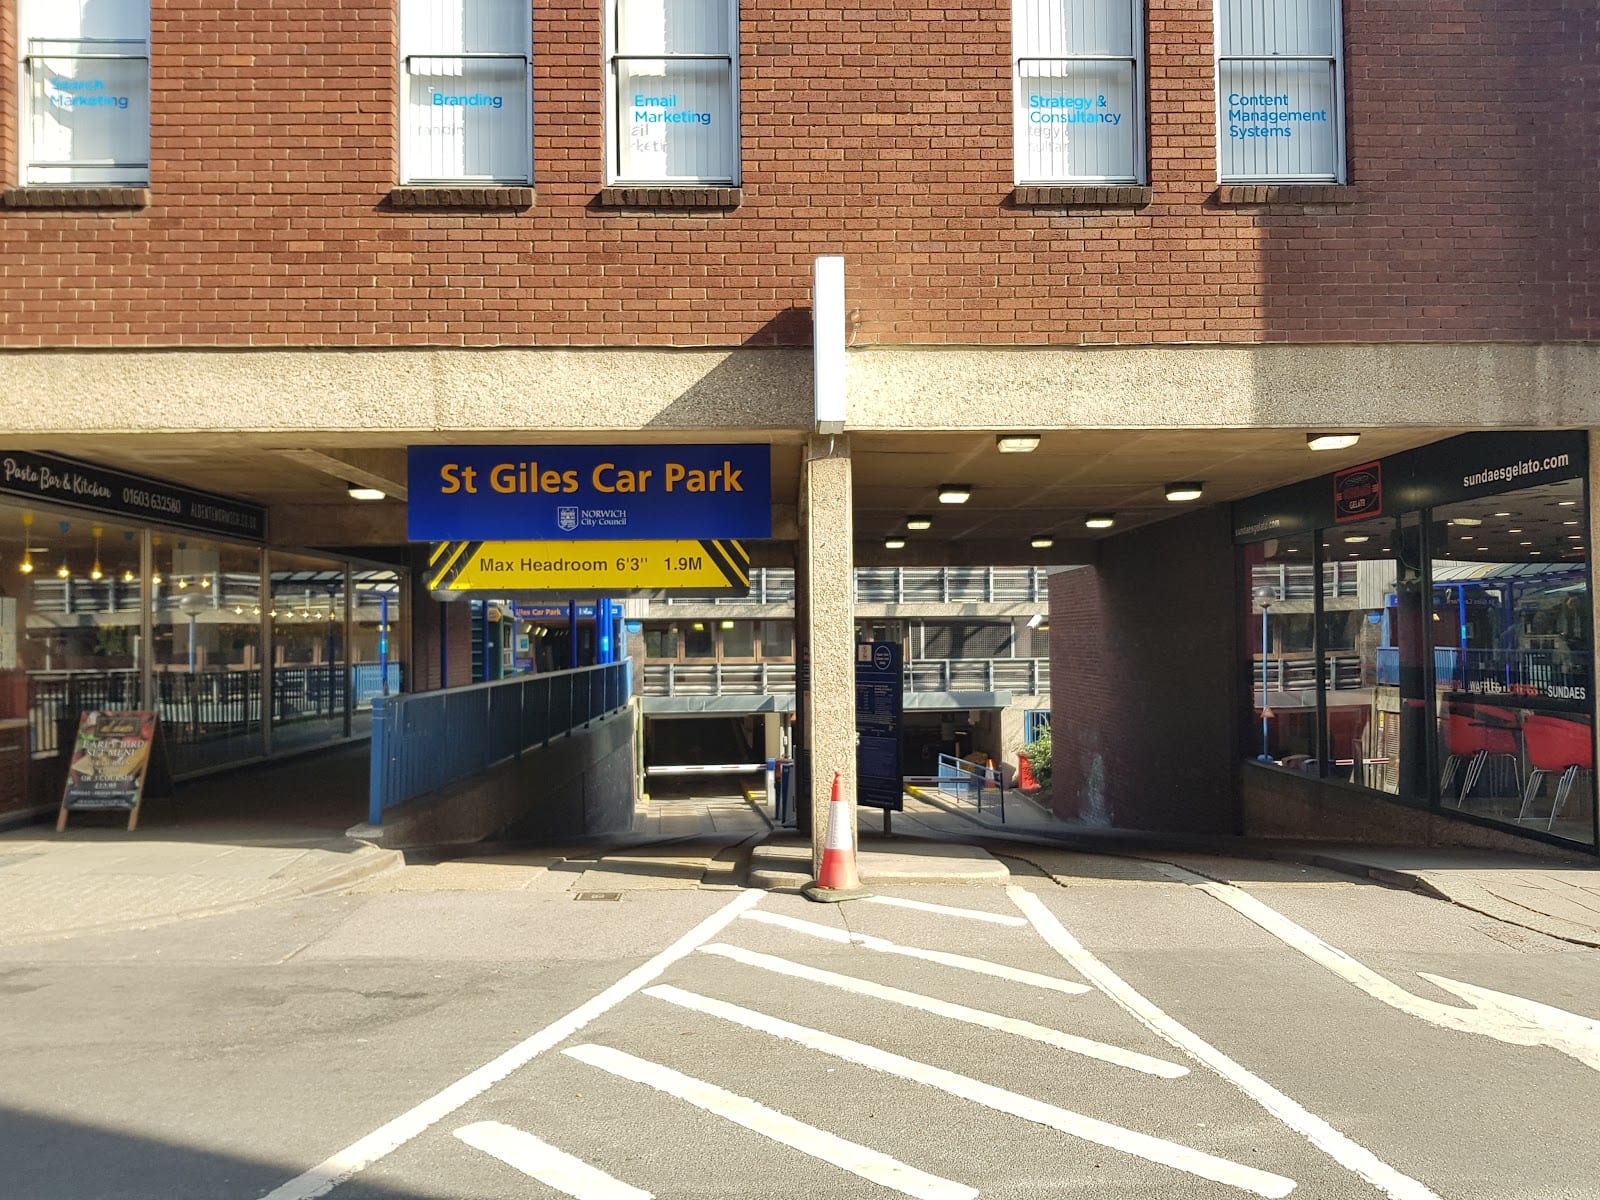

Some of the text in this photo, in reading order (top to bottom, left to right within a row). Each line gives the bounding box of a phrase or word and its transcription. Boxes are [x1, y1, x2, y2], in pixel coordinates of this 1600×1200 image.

[50, 95, 129, 109] Marketing
[433, 93, 503, 109] Branding
[634, 94, 677, 107] Email
[1030, 95, 1107, 110] Strategy &
[1228, 94, 1289, 106] Content
[635, 110, 711, 125] Marketing
[1030, 111, 1121, 125] Consultancy
[1228, 109, 1327, 123] Management
[1229, 125, 1292, 139] Systems
[439, 460, 745, 495] St Giles Car Park
[1463, 453, 1569, 488] sundaesgelato.com
[4, 458, 112, 498] Pasta Bar & Kitchen
[122, 487, 181, 514] 01603 632580
[581, 509, 627, 518] NORWICH
[581, 518, 627, 527] City Council
[480, 558, 514, 572] Max
[520, 557, 608, 572] Headroom
[664, 557, 703, 571] 1.9M
[1547, 686, 1586, 700] SUNDAES
